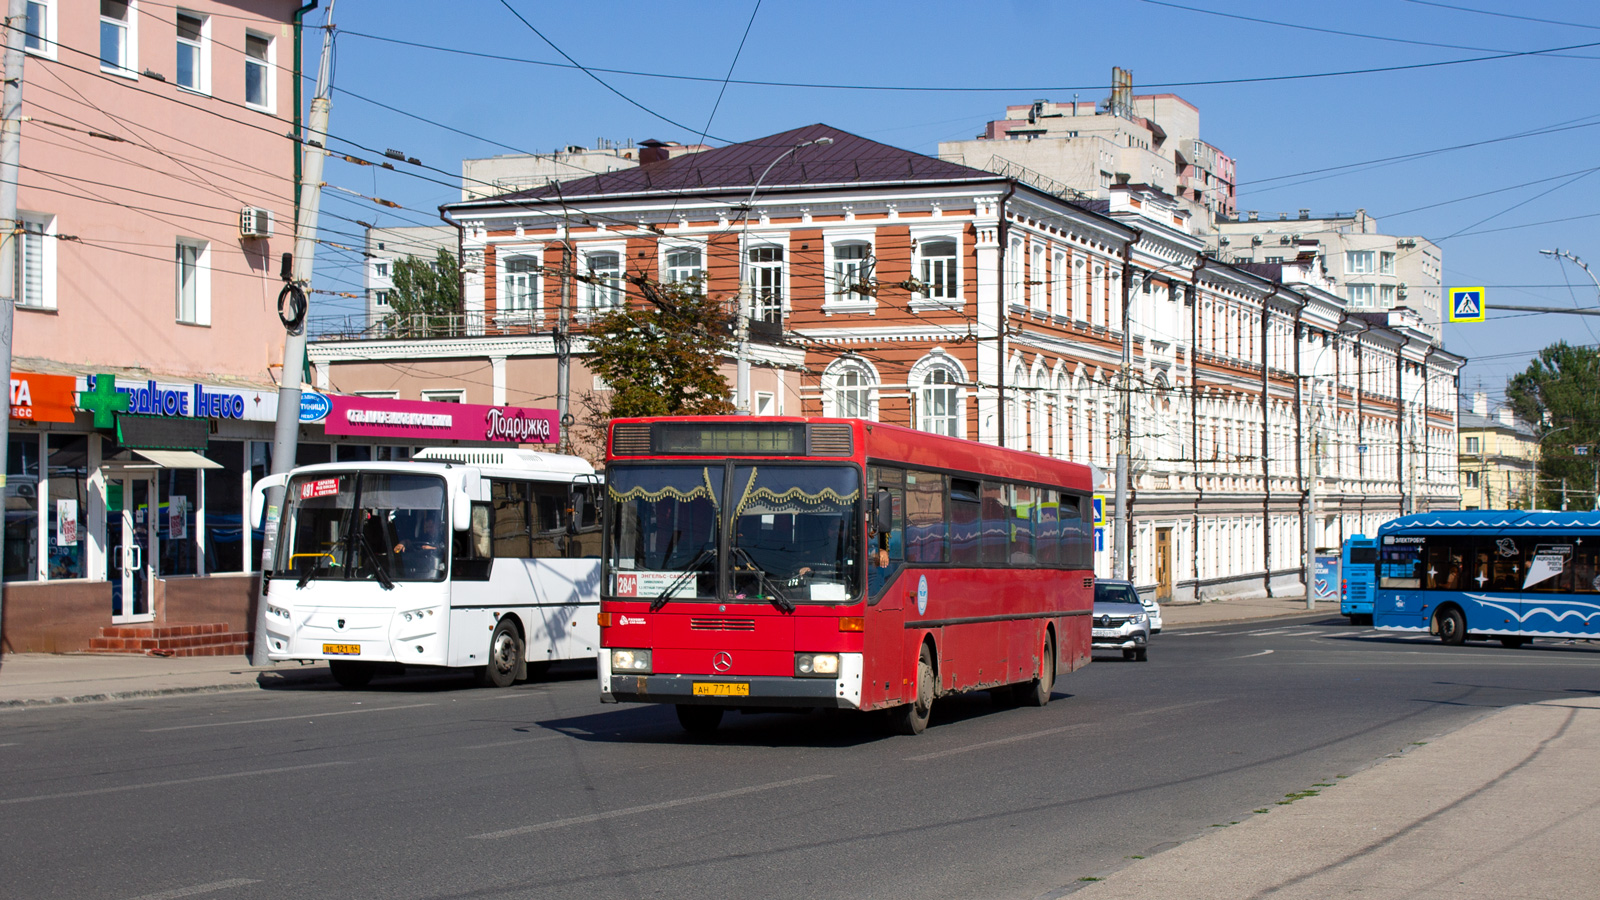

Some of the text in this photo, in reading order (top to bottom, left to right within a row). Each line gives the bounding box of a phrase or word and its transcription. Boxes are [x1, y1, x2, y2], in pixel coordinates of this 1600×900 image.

[10, 379, 32, 406] ТА
[300, 403, 325, 411] ТИНИЦА
[487, 408, 550, 439] Подружка
[303, 483, 314, 497] 491
[698, 684, 746, 694] АН 771 64
